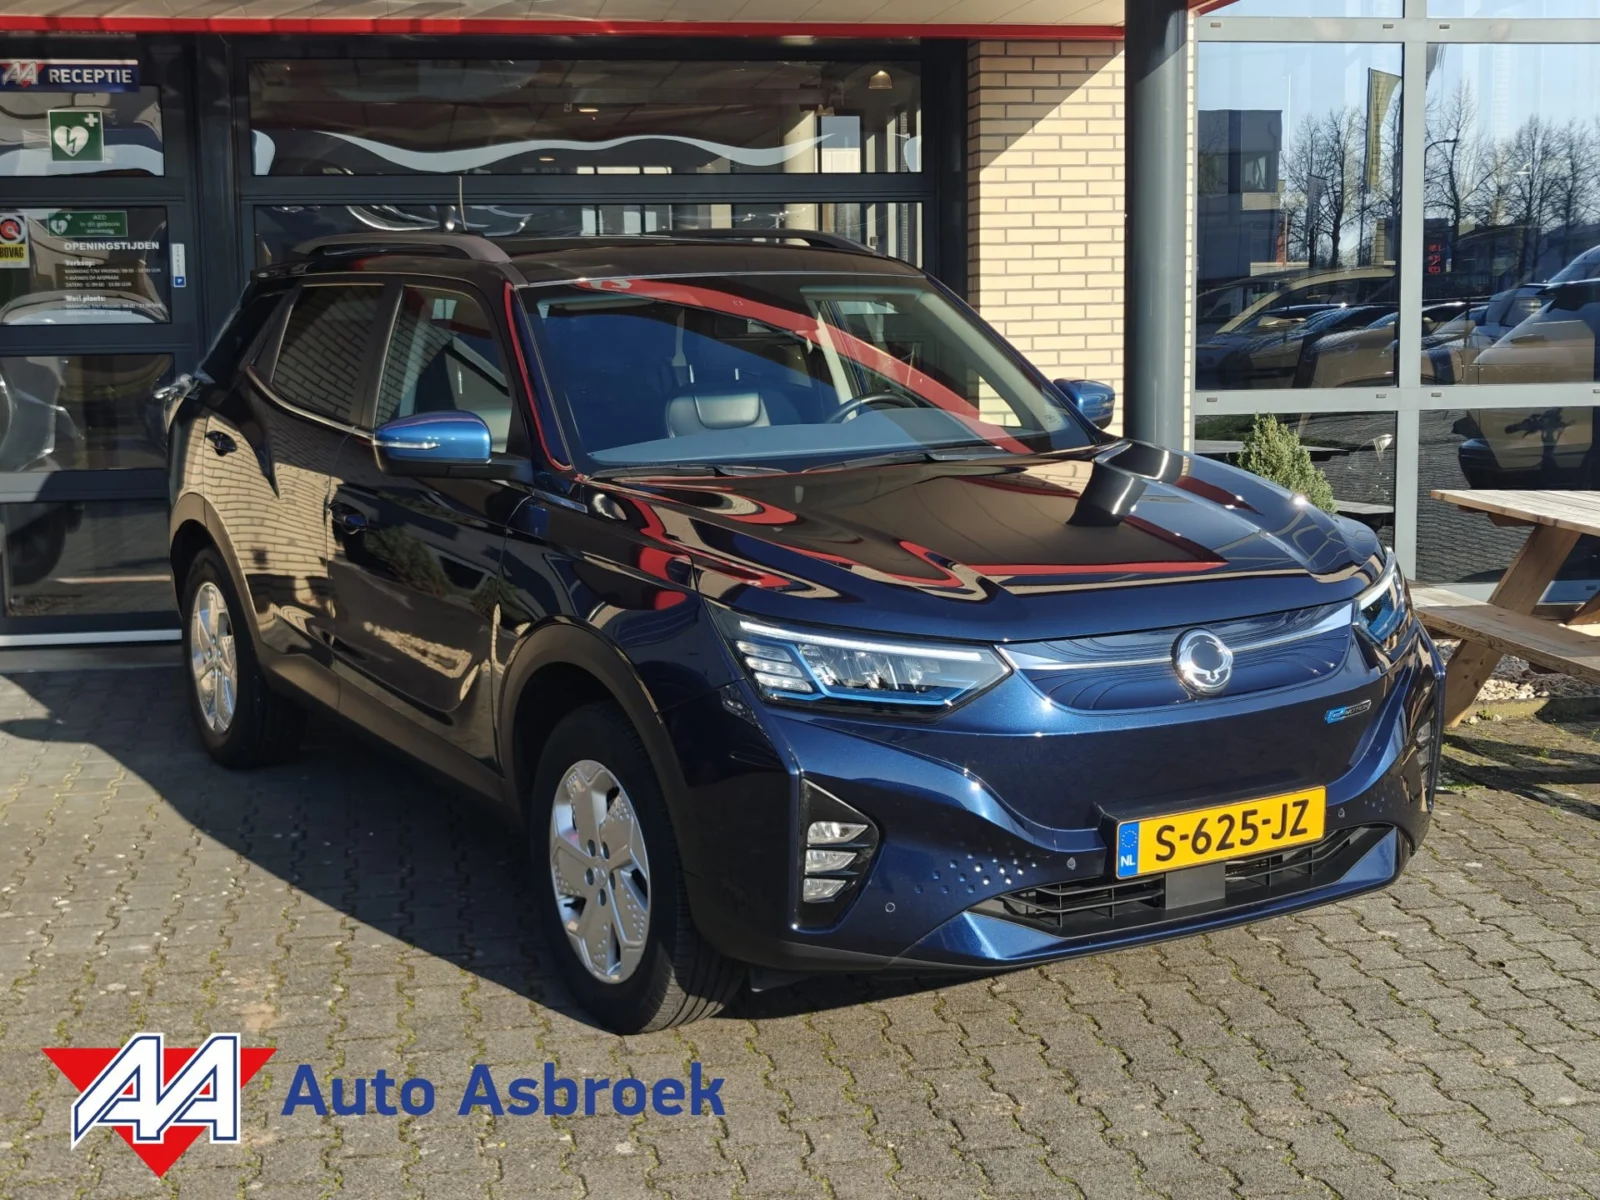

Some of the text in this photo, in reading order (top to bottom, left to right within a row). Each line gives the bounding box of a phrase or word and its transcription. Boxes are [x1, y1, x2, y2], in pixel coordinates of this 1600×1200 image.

[49, 68, 133, 84] RECEPTIE
[0, 246, 24, 259] BOVAG
[64, 241, 160, 251] OPENINGSTIJDEN
[65, 259, 96, 268] Verkoop:
[1155, 798, 1310, 862] S-625-JZ
[1120, 854, 1136, 867] NL
